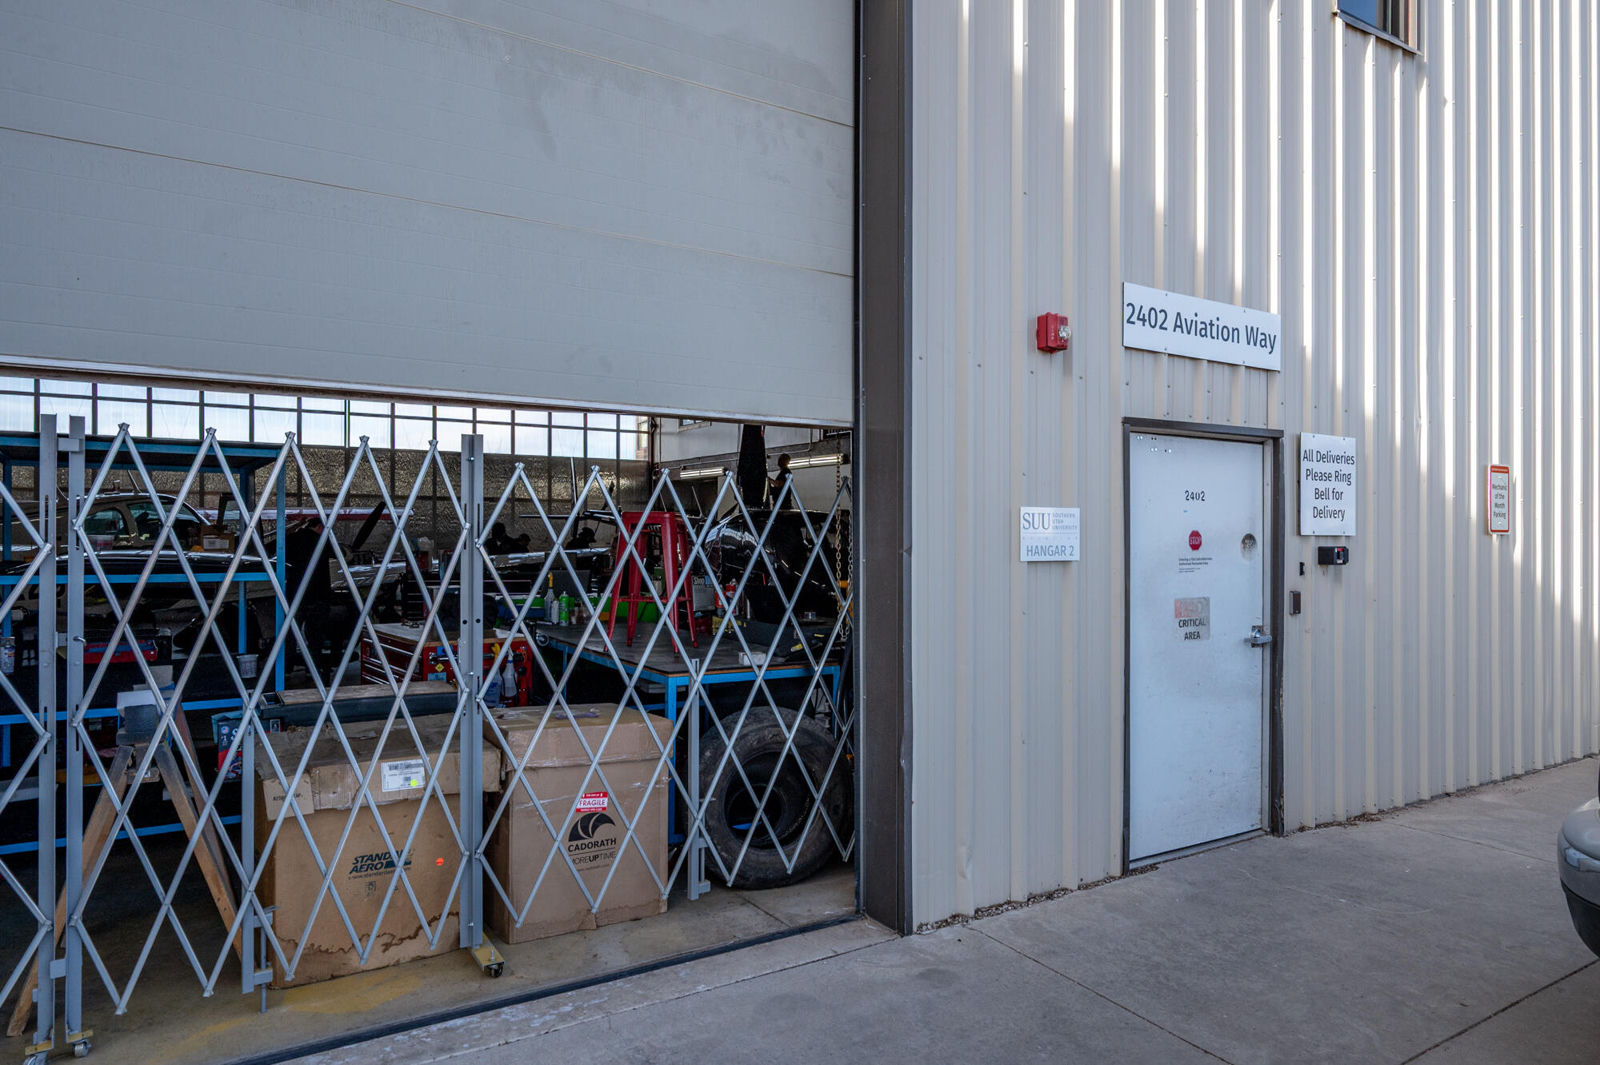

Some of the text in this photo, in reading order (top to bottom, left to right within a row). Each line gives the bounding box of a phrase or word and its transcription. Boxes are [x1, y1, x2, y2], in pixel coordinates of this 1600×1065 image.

[1126, 302, 1277, 355] 2402 Aviation Way
[1302, 449, 1355, 465] All Deliveries
[1305, 468, 1352, 486] Please Ring
[1184, 490, 1206, 501] 2402
[1314, 487, 1344, 501] Bell for
[1313, 505, 1345, 521] Delivery
[1022, 512, 1050, 530] SUU
[1026, 544, 1075, 557] HANGAR 2
[1178, 617, 1207, 628] CRITICAL
[1184, 631, 1201, 641] AREA
[579, 799, 606, 807] FRAGILE
[568, 838, 617, 852] CADORATH
[349, 861, 384, 875] AERO
